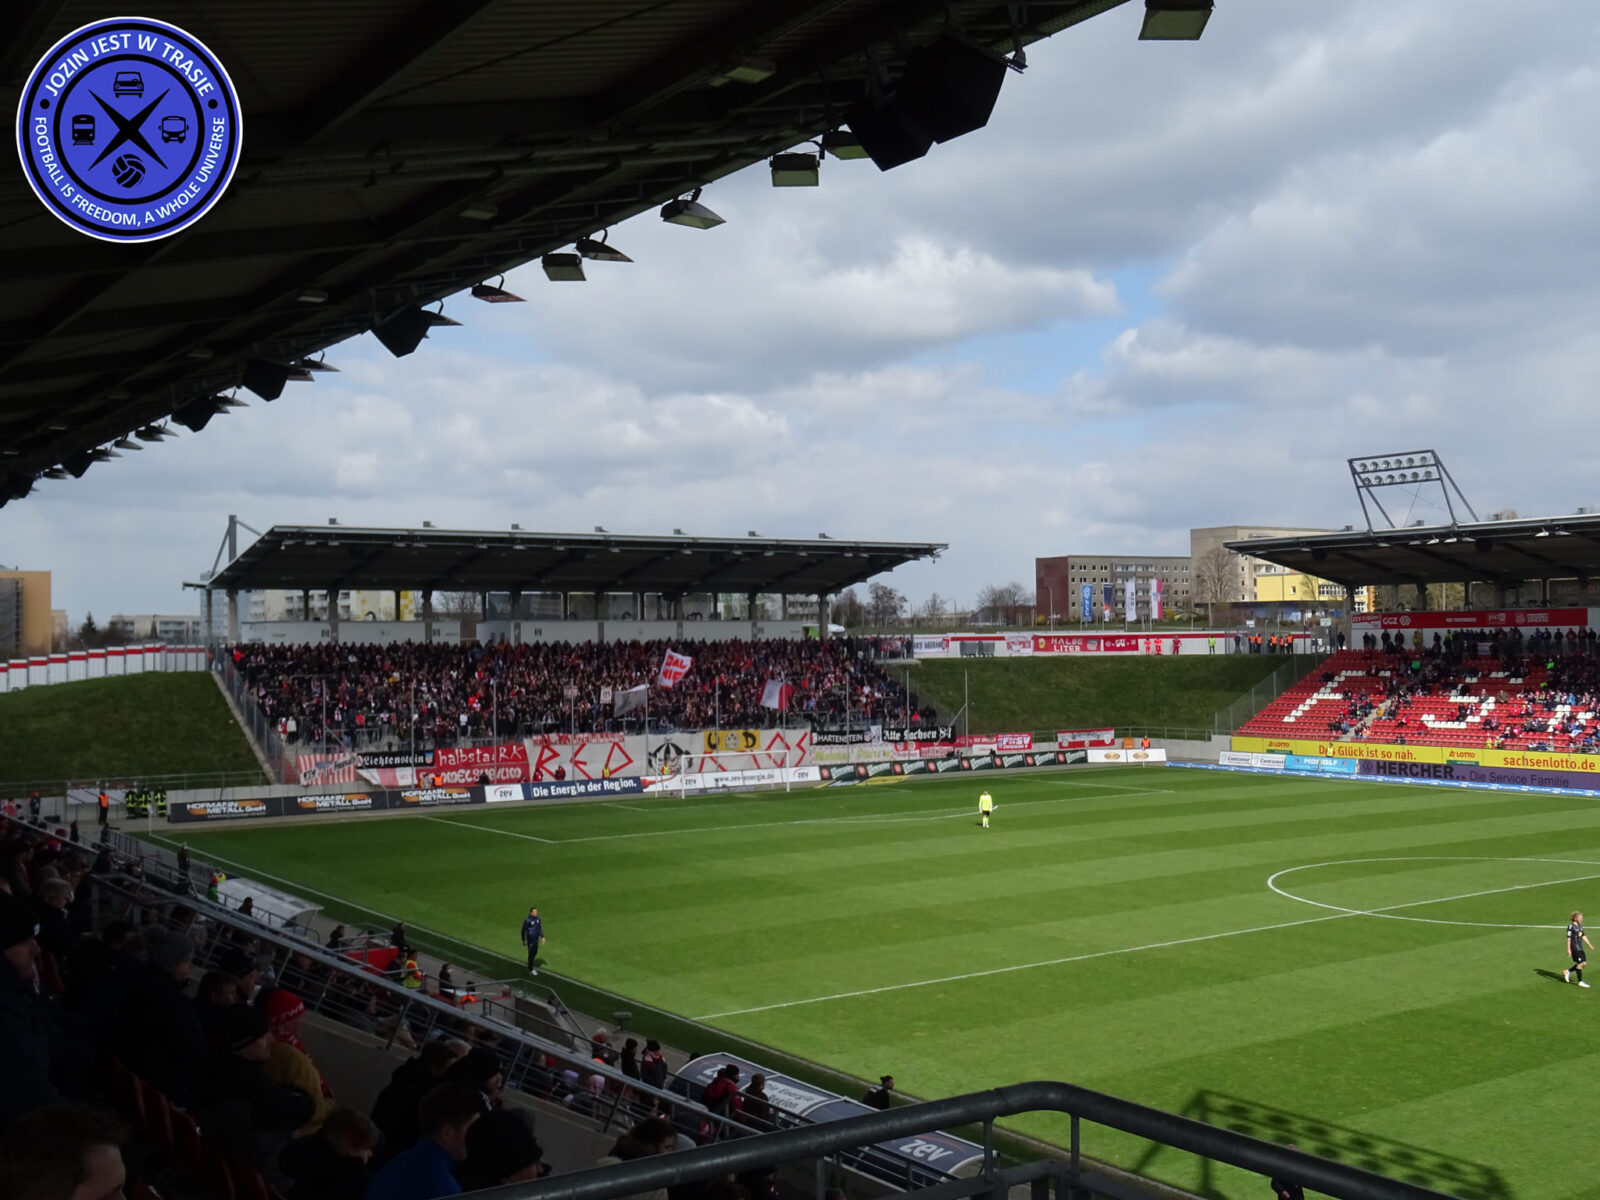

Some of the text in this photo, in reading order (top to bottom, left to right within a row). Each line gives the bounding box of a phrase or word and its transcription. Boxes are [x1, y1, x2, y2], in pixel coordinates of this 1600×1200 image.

[1382, 615, 1398, 625] GGZ
[1051, 637, 1083, 645] HALBE
[1053, 645, 1081, 653] LITER
[818, 734, 863, 743] HARTENSTEIN
[883, 728, 901, 741] Alte
[904, 727, 937, 740] Sachsen
[1338, 745, 1364, 758] Glück
[1366, 749, 1379, 759] ist
[1381, 751, 1393, 760] so
[1395, 749, 1417, 761] nah.
[1457, 751, 1475, 759] LOTTO
[1503, 754, 1596, 771] sachsenlotto.de
[1469, 770, 1486, 782] Die
[1489, 772, 1528, 785] Service
[1530, 774, 1569, 789] Familie
[401, 788, 446, 797] HOFMANN
[498, 788, 513, 798] zev
[532, 778, 637, 798] Die Energie der Region.
[297, 794, 346, 803] HOFMANN
[420, 791, 470, 801] METALL GmbH
[187, 800, 239, 810] HOFMANN
[316, 797, 372, 808] METALL GmbH
[206, 805, 244, 815] METALL
[899, 1139, 954, 1162] zev
